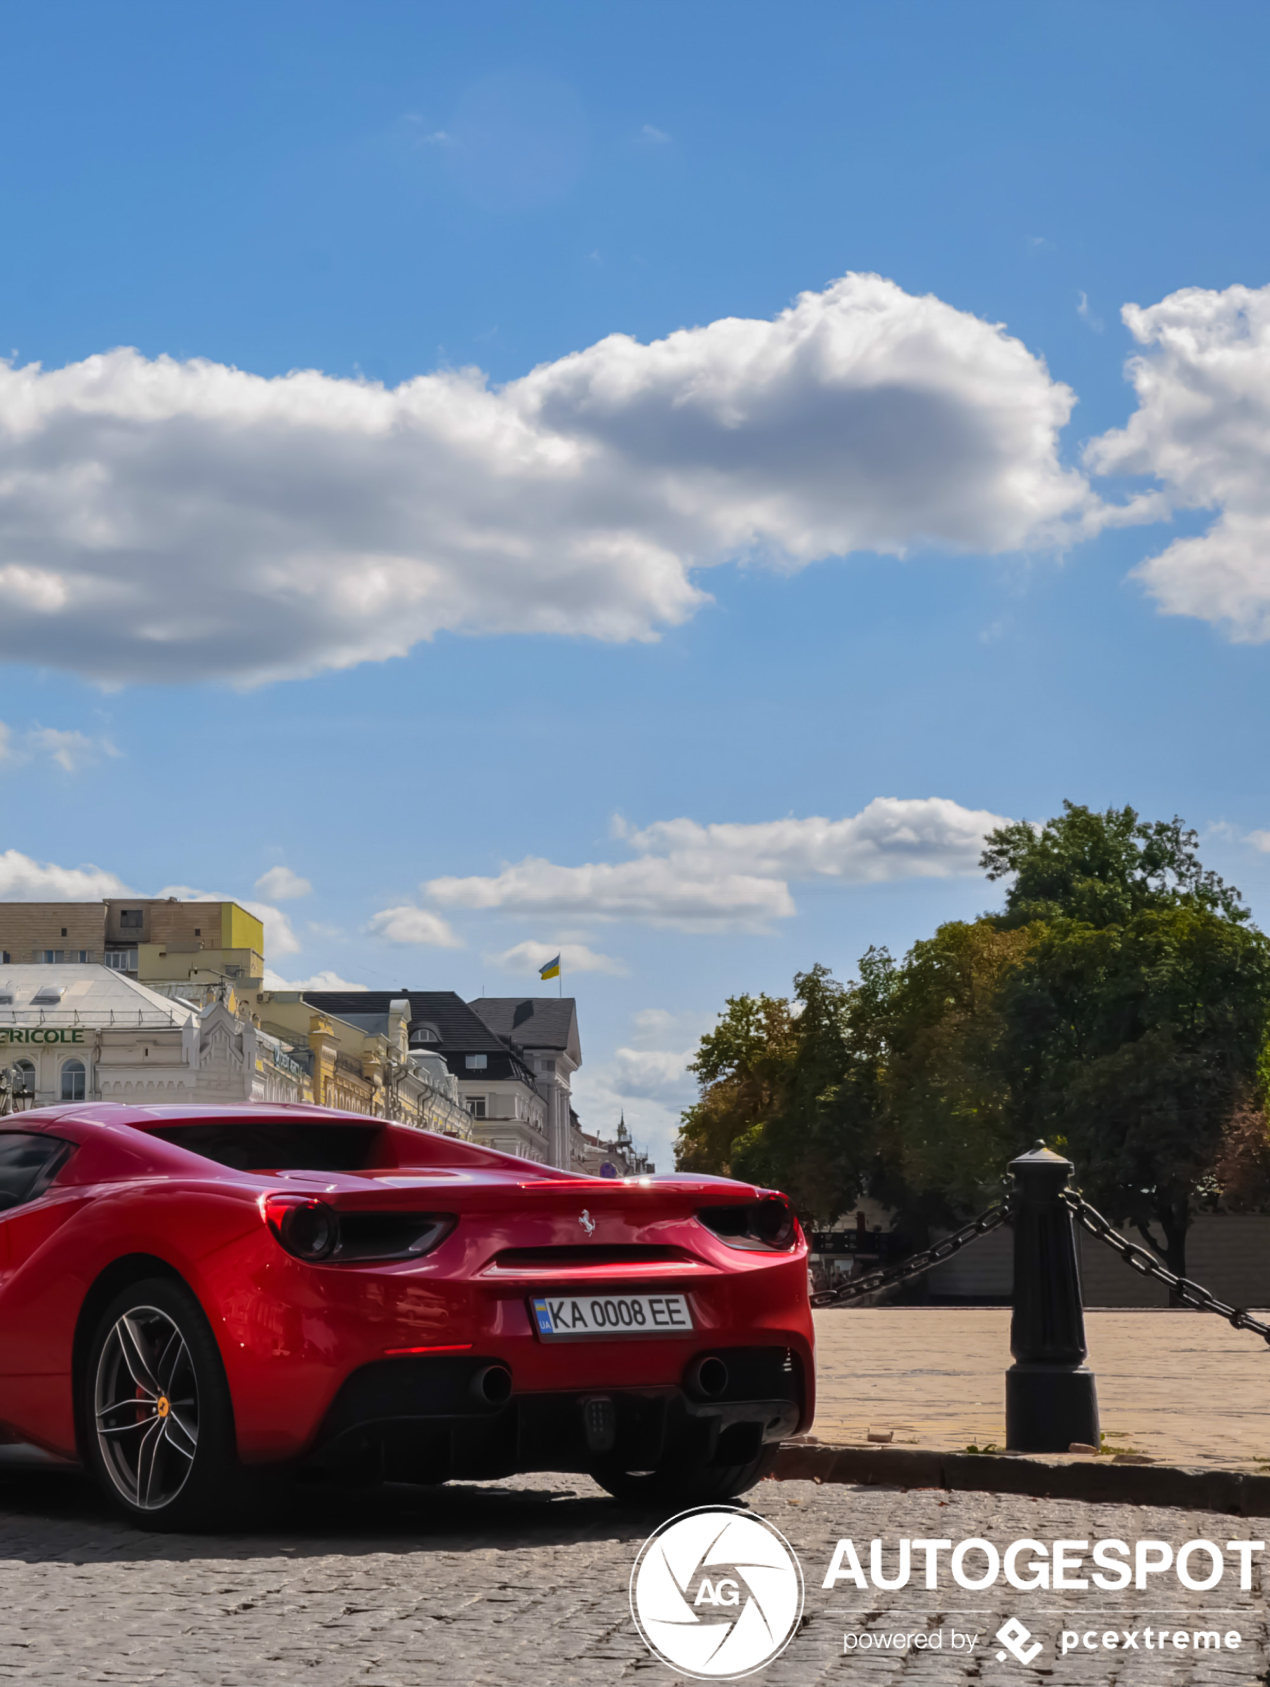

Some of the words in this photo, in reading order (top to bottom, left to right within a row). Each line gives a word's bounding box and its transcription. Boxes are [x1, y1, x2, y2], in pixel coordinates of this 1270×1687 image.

[548, 1301, 589, 1329] KA
[590, 1299, 647, 1327] 0008
[648, 1298, 686, 1326] EE
[540, 1321, 552, 1330] UA
